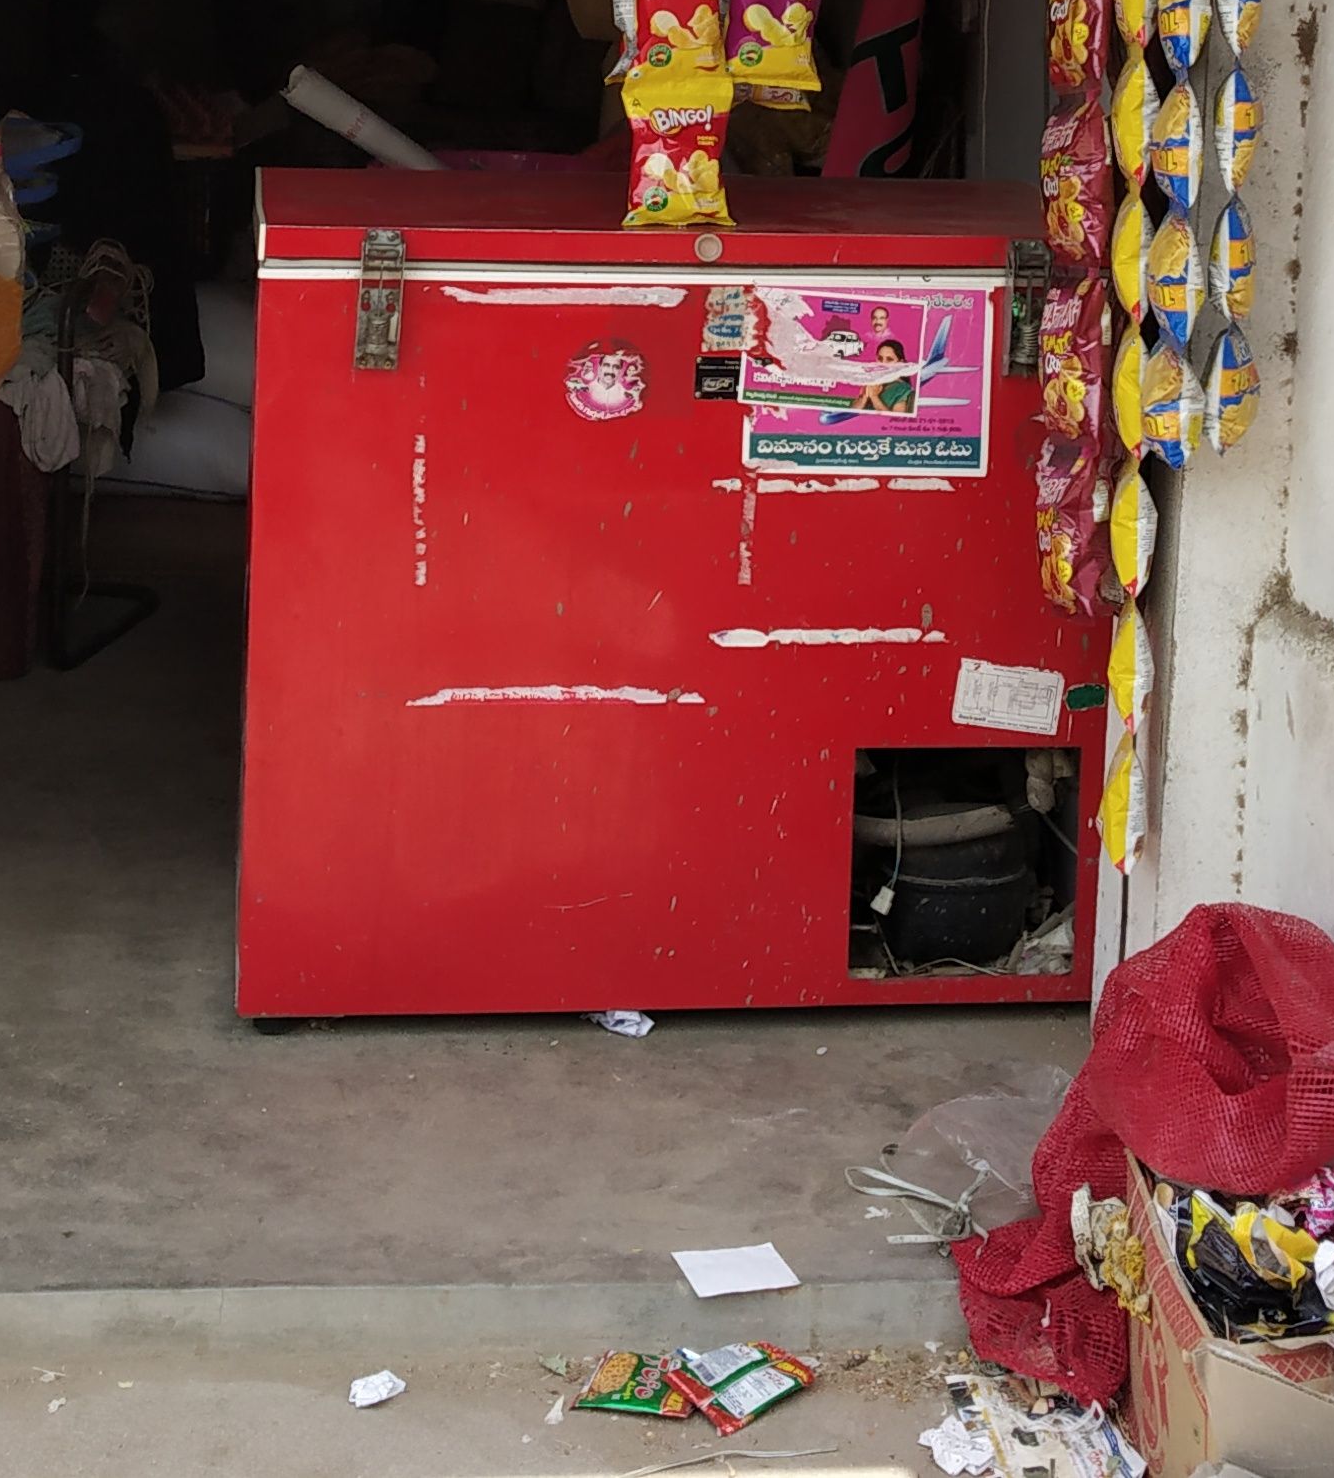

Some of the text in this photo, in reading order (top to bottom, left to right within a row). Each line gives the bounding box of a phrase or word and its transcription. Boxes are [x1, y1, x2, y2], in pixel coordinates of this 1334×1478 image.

[653, 106, 713, 133] BINGO!
[757, 438, 833, 455] విమానం
[894, 439, 932, 456] మన
[935, 441, 973, 458] ఓటు
